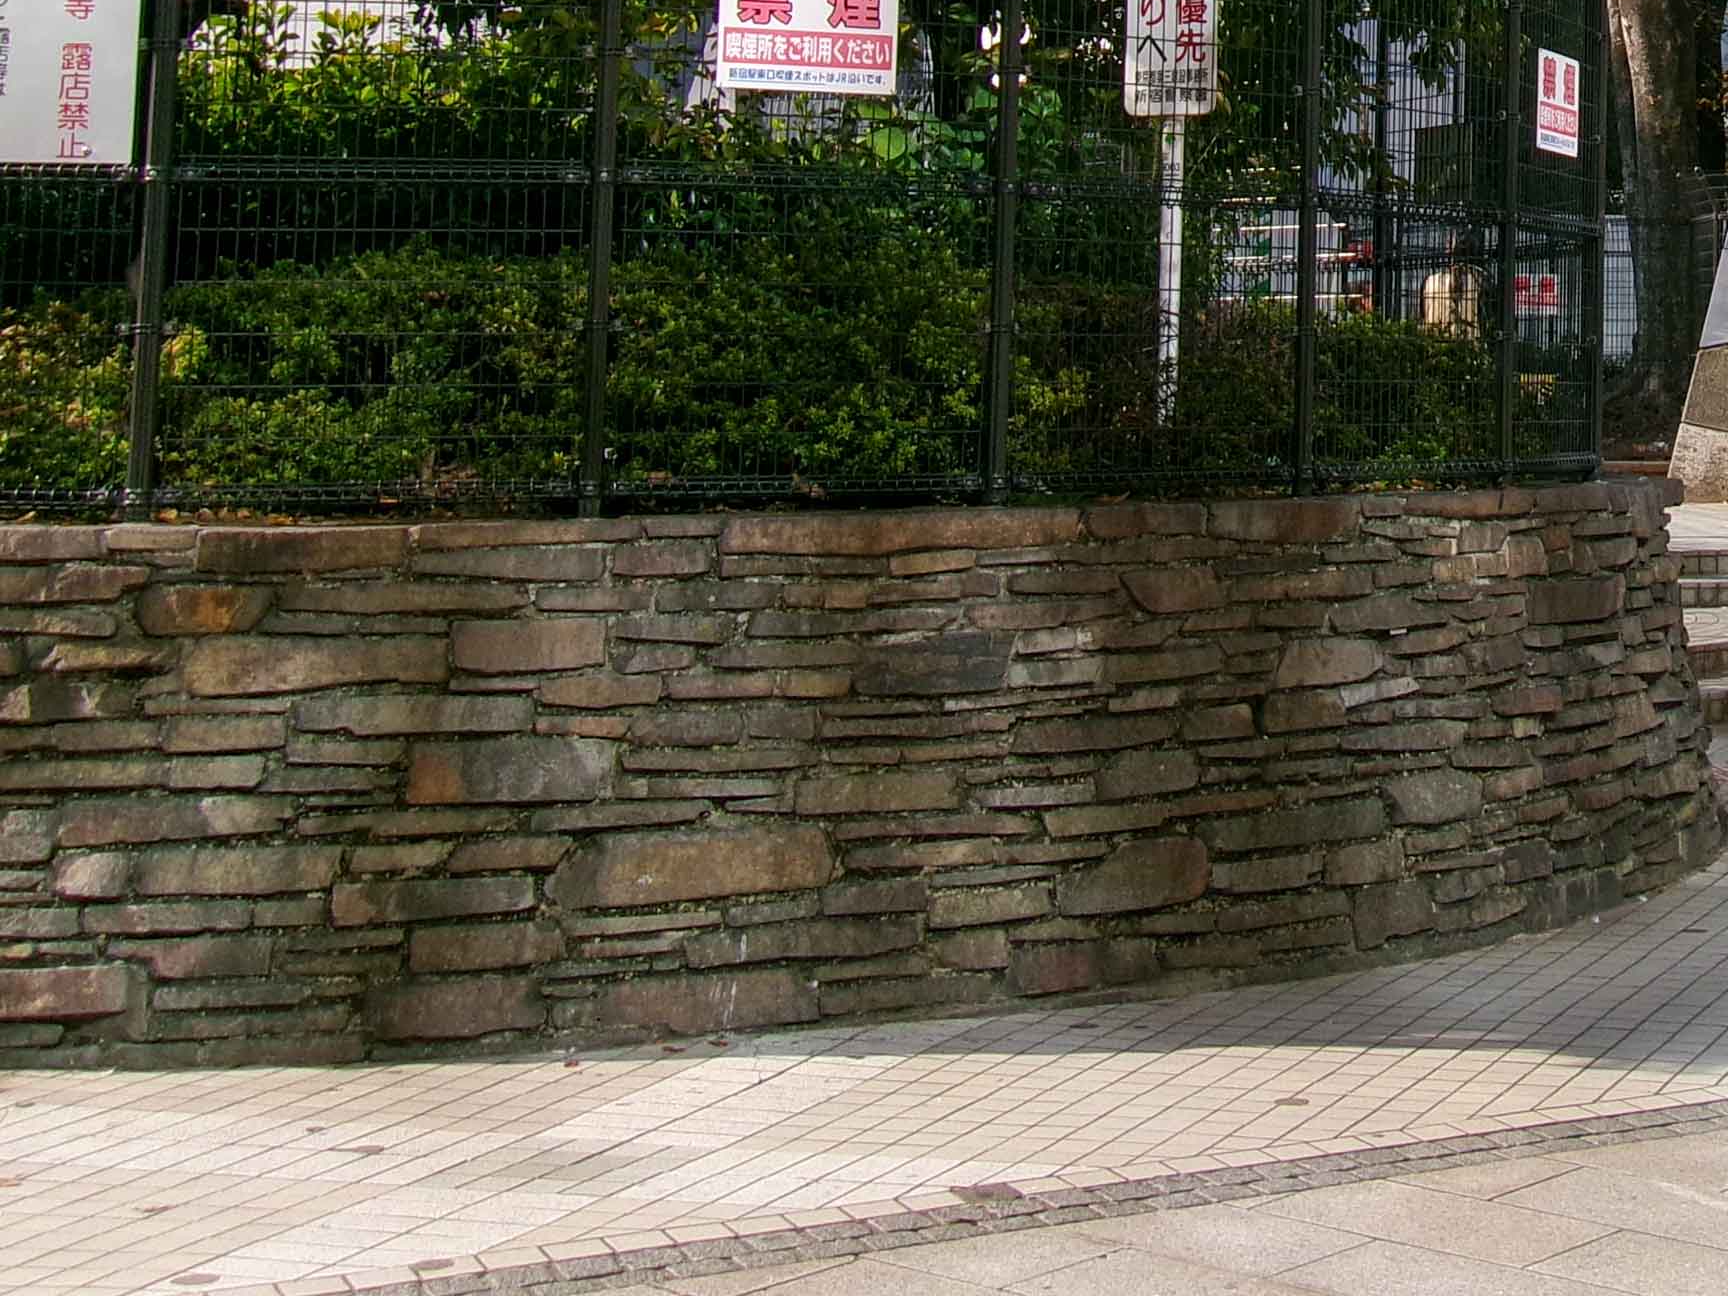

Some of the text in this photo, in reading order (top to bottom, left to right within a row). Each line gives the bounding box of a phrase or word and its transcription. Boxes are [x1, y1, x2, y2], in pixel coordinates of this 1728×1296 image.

[726, 32, 890, 65] 喫煙所をご利用ください
[56, 42, 93, 159] 露店禁止
